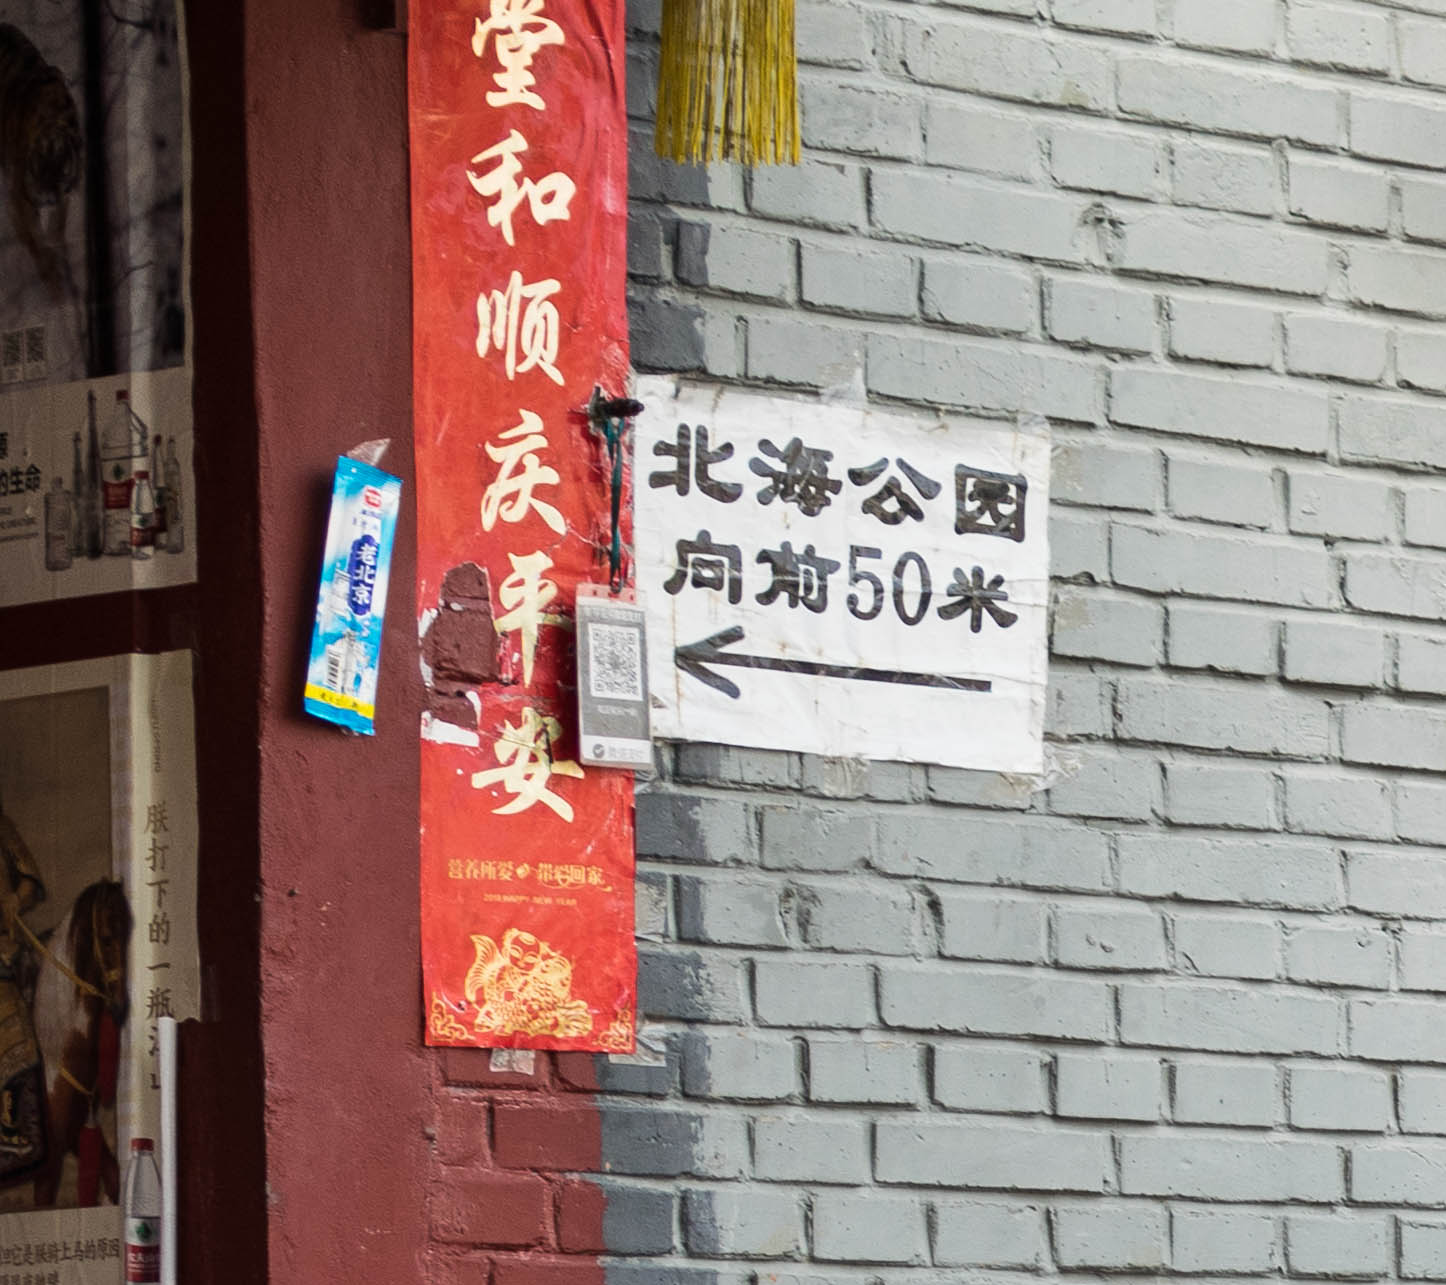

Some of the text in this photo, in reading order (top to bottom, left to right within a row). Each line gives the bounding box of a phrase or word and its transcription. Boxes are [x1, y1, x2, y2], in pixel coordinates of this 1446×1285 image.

[648, 422, 1028, 543] 北海公园
[663, 529, 1019, 634] 向前50米
